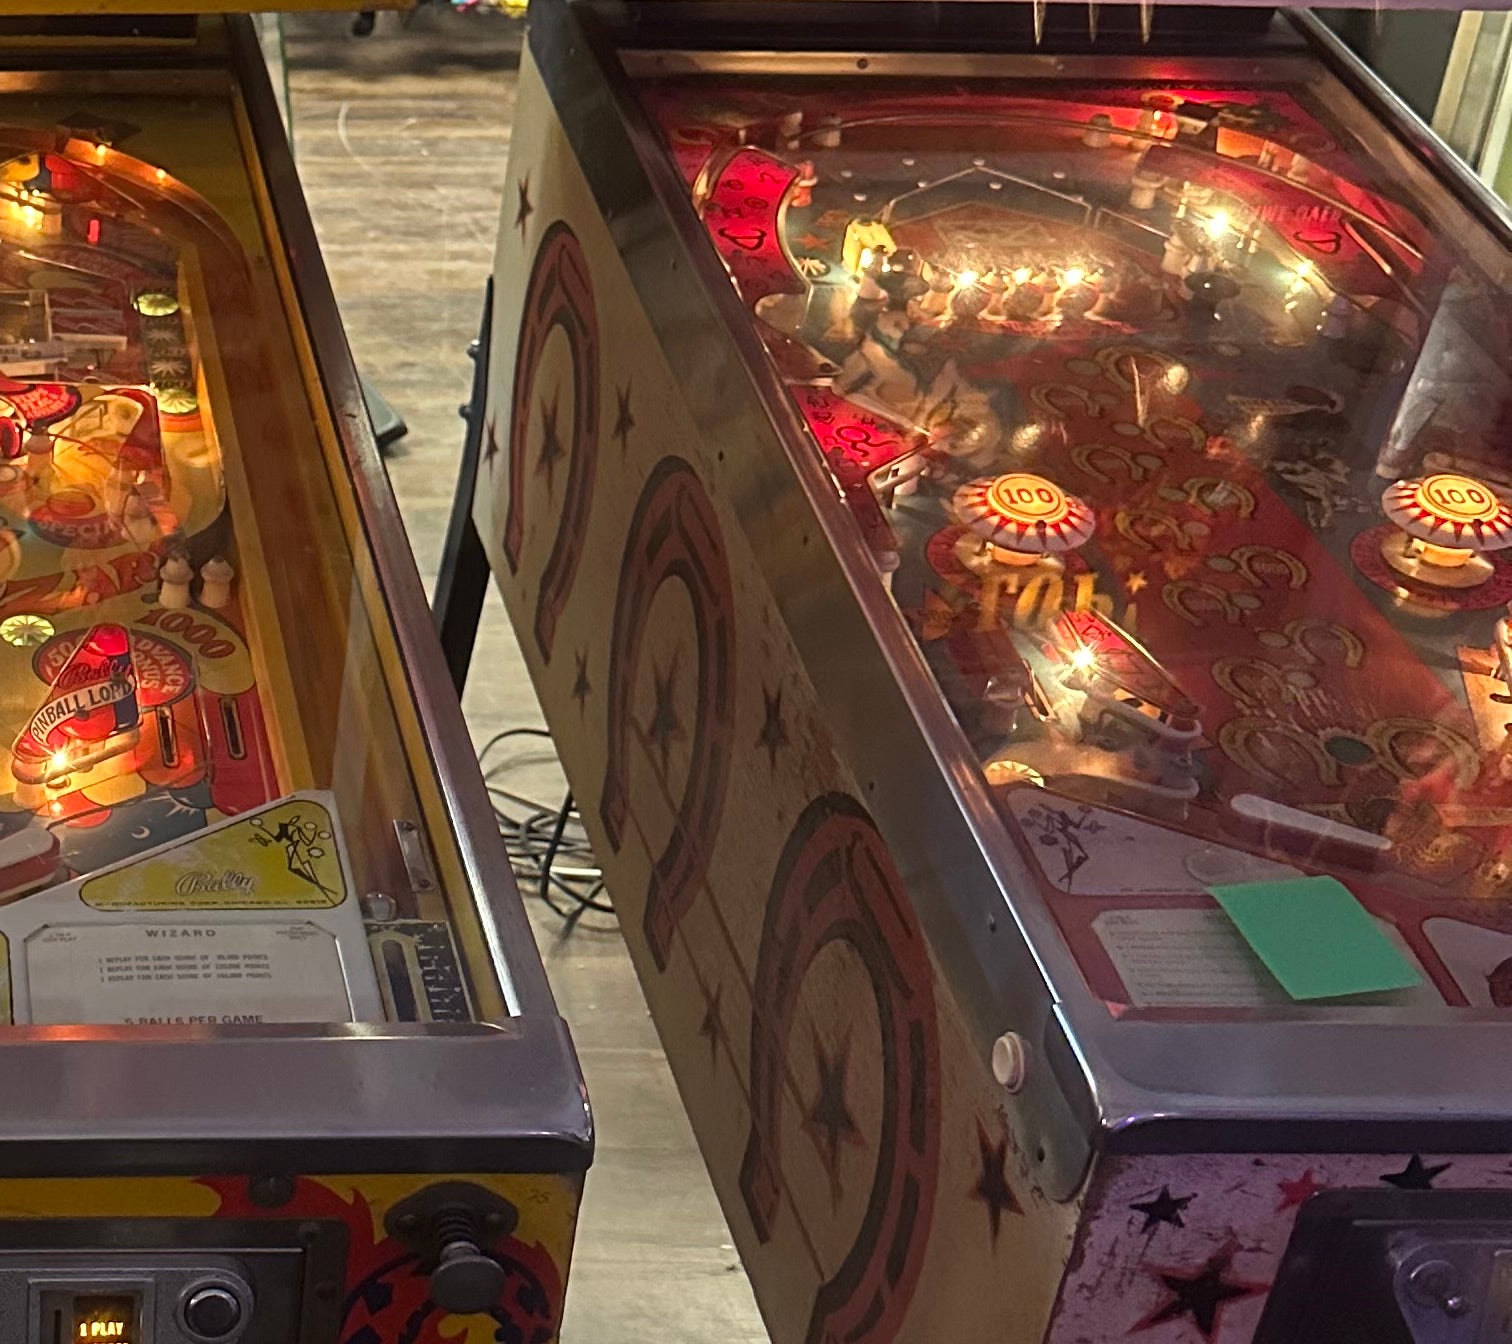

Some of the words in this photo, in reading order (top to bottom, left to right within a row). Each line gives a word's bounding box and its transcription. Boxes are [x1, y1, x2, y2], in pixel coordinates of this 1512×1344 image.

[1002, 487, 1054, 505] 100
[1433, 488, 1486, 505] 100
[136, 608, 237, 659] 1000
[140, 637, 188, 695] DVANCE
[31, 692, 88, 740] PINBALL
[87, 676, 135, 707] LORD
[175, 870, 257, 897] Bally
[145, 929, 217, 938] WIZARD
[189, 1015, 217, 1024] PER
[221, 1015, 264, 1024] GAME
[79, 1321, 88, 1336] 1
[90, 1321, 124, 1336] PLAY
